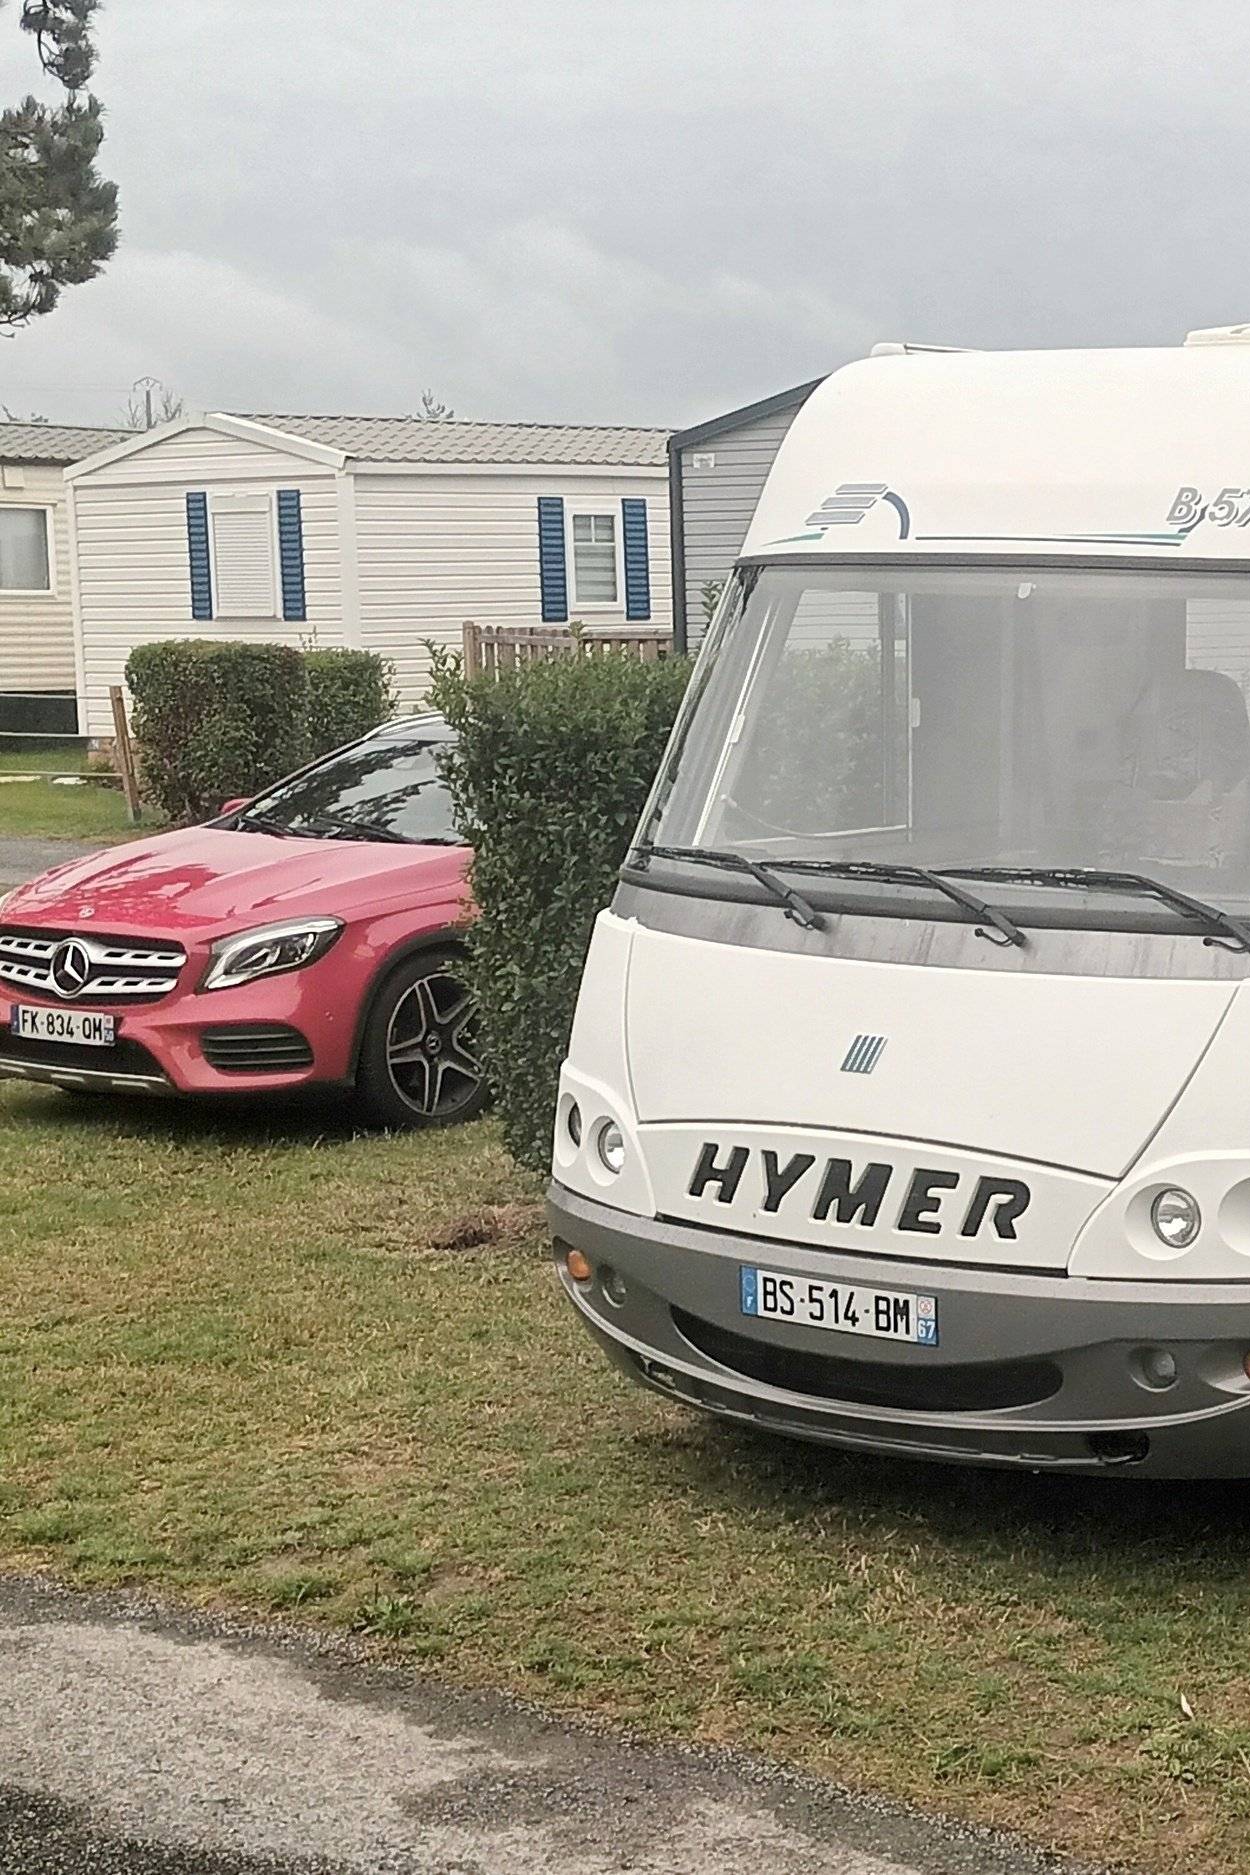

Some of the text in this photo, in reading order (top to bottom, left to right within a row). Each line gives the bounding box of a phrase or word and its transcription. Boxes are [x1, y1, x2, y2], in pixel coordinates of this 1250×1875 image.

[1165, 486, 1201, 526] B
[687, 1142, 1032, 1240] HYMER
[917, 1319, 936, 1339] 67
